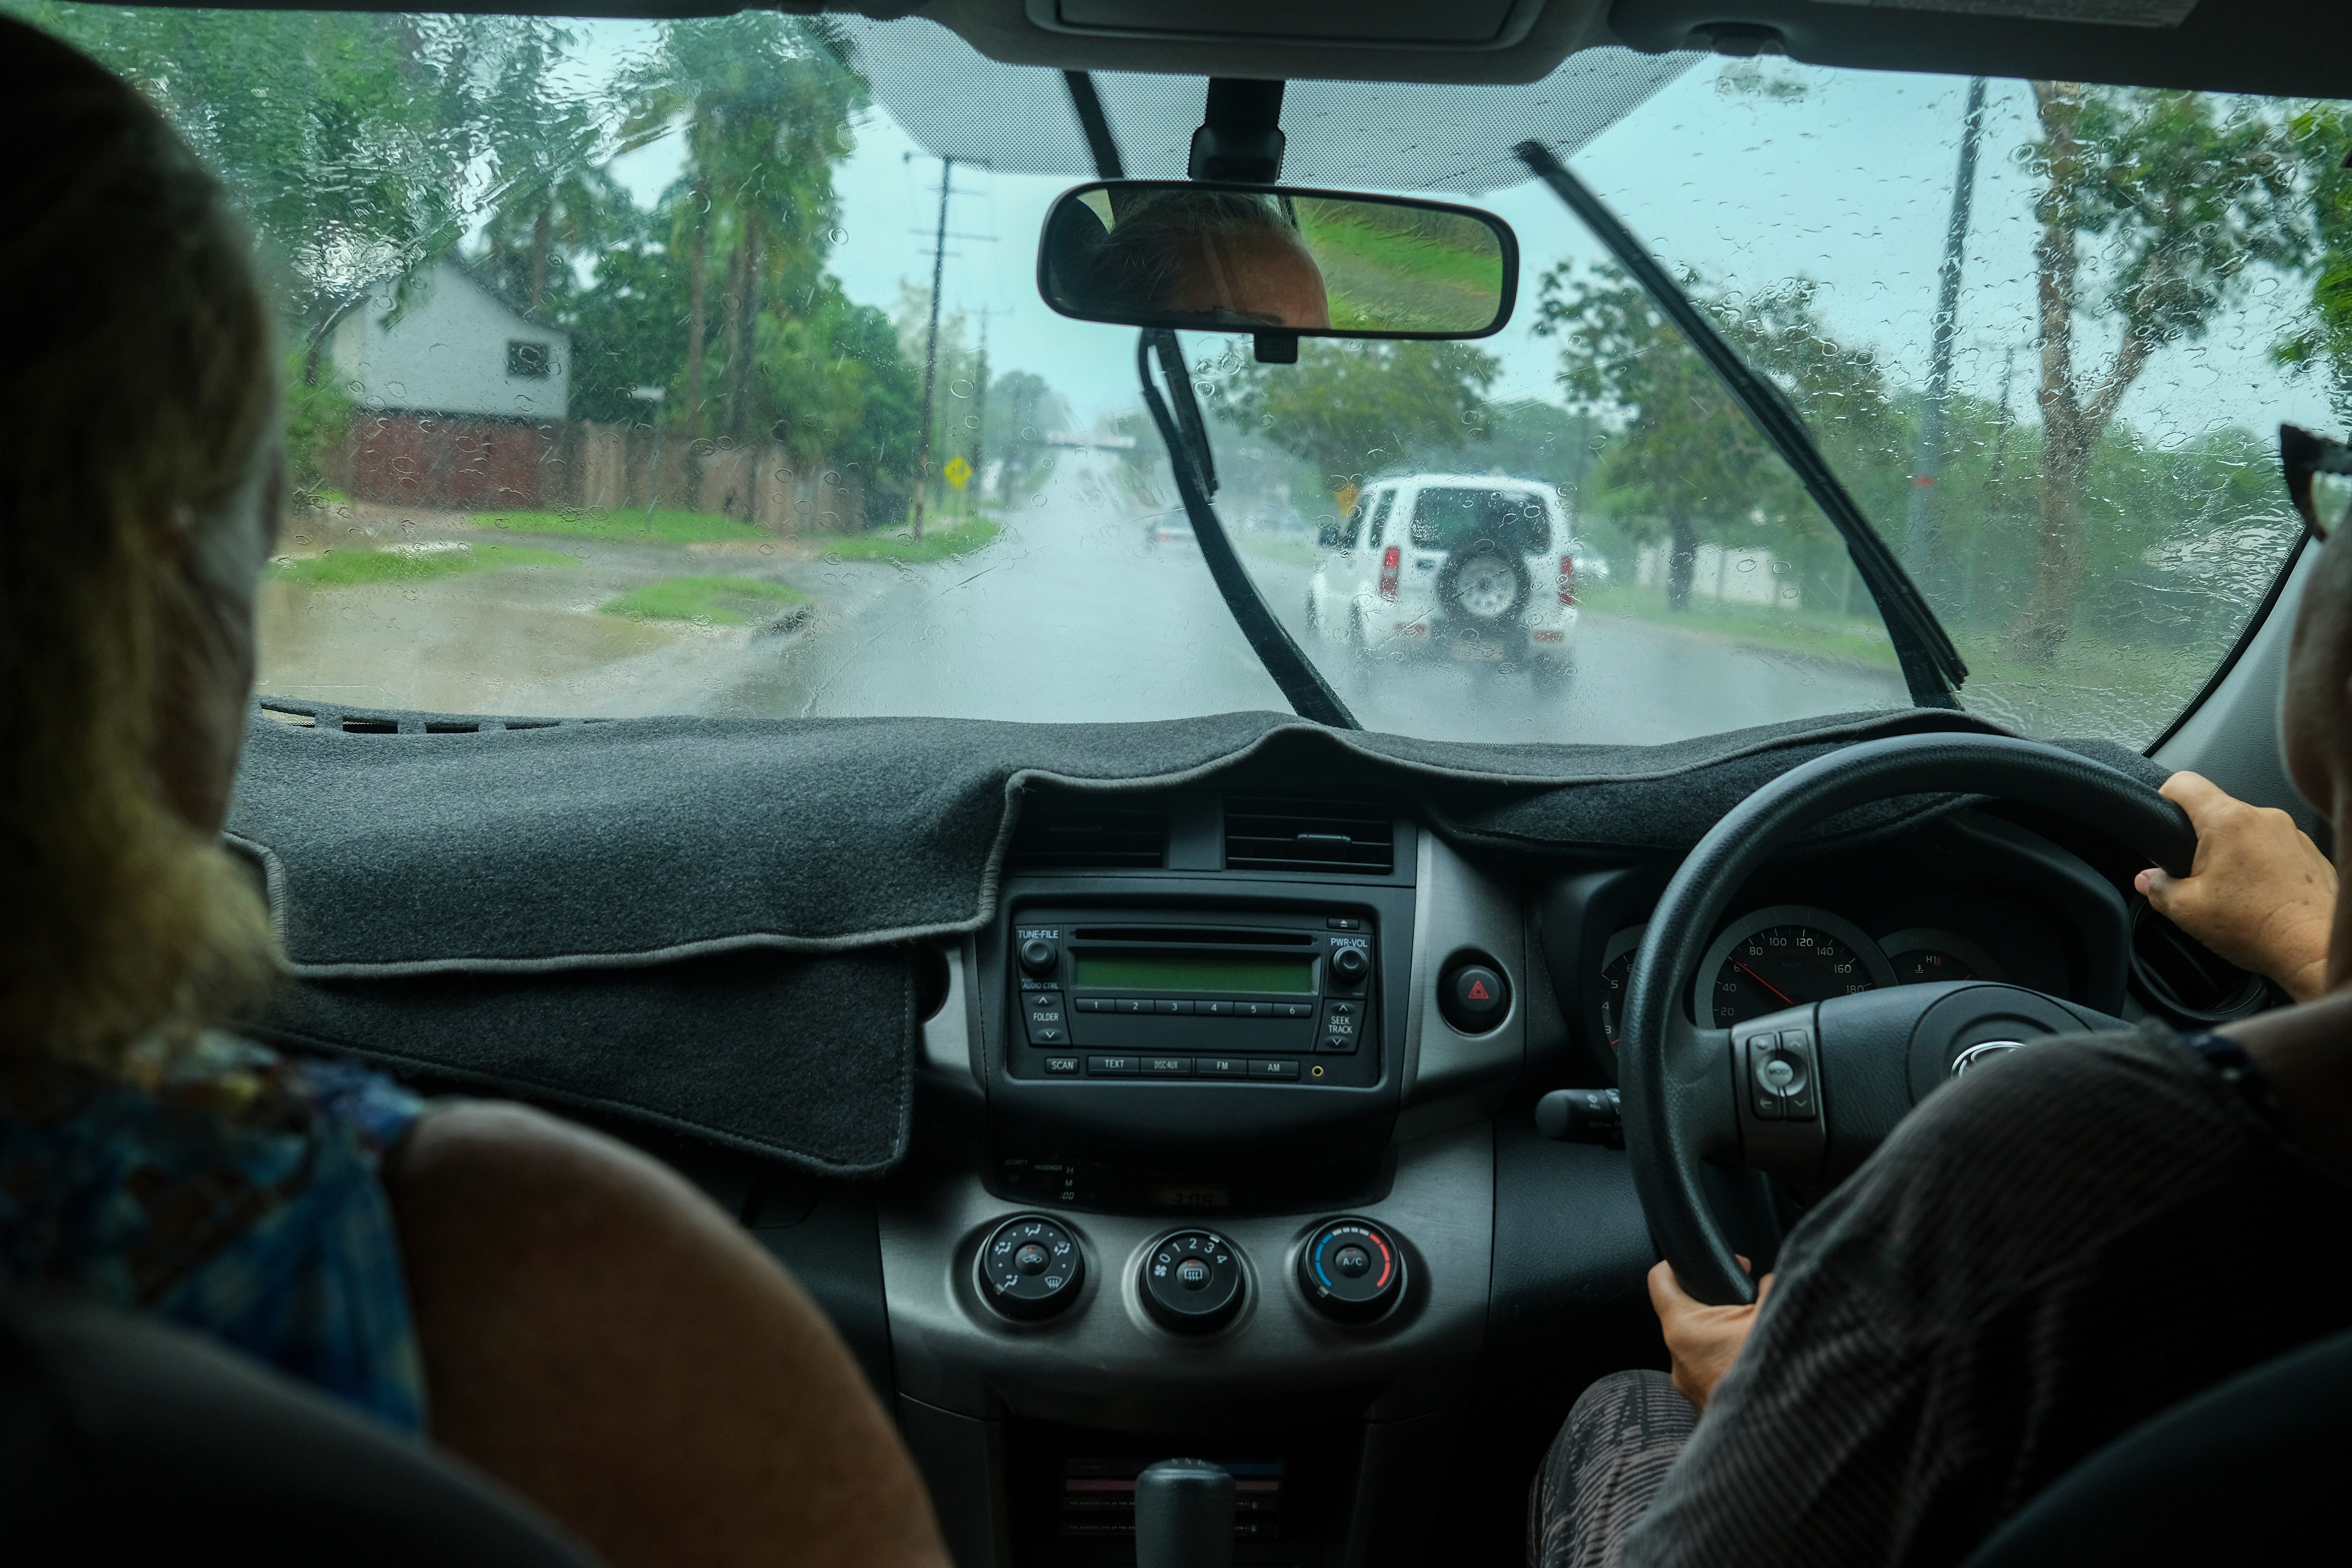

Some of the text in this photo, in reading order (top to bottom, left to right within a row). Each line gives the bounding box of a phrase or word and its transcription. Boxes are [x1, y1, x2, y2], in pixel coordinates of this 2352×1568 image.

[1770, 937, 1787, 946] 100
[1797, 938, 1813, 946] 120
[1749, 946, 1763, 955] 80
[1816, 947, 1833, 956] 140
[1834, 965, 1851, 973] 160
[1723, 983, 1736, 992] 40
[1847, 985, 1864, 994] 180
[1602, 1001, 1609, 1010] 4
[1721, 1007, 1734, 1016] 20
[1033, 1012, 1059, 1021] FOLDER
[1331, 1016, 1350, 1024] SEEK
[1328, 1024, 1352, 1034] TRACK
[1605, 1025, 1611, 1034] 3
[1052, 1060, 1074, 1070] SCAN
[1104, 1059, 1124, 1068] TEXT
[1217, 1061, 1228, 1070] FM
[1268, 1063, 1280, 1072] AM
[1189, 1237, 1197, 1249] 2
[1204, 1242, 1215, 1253] 3
[1173, 1243, 1181, 1253] 1
[1217, 1255, 1228, 1264] 4
[1343, 1257, 1363, 1266] A/C
